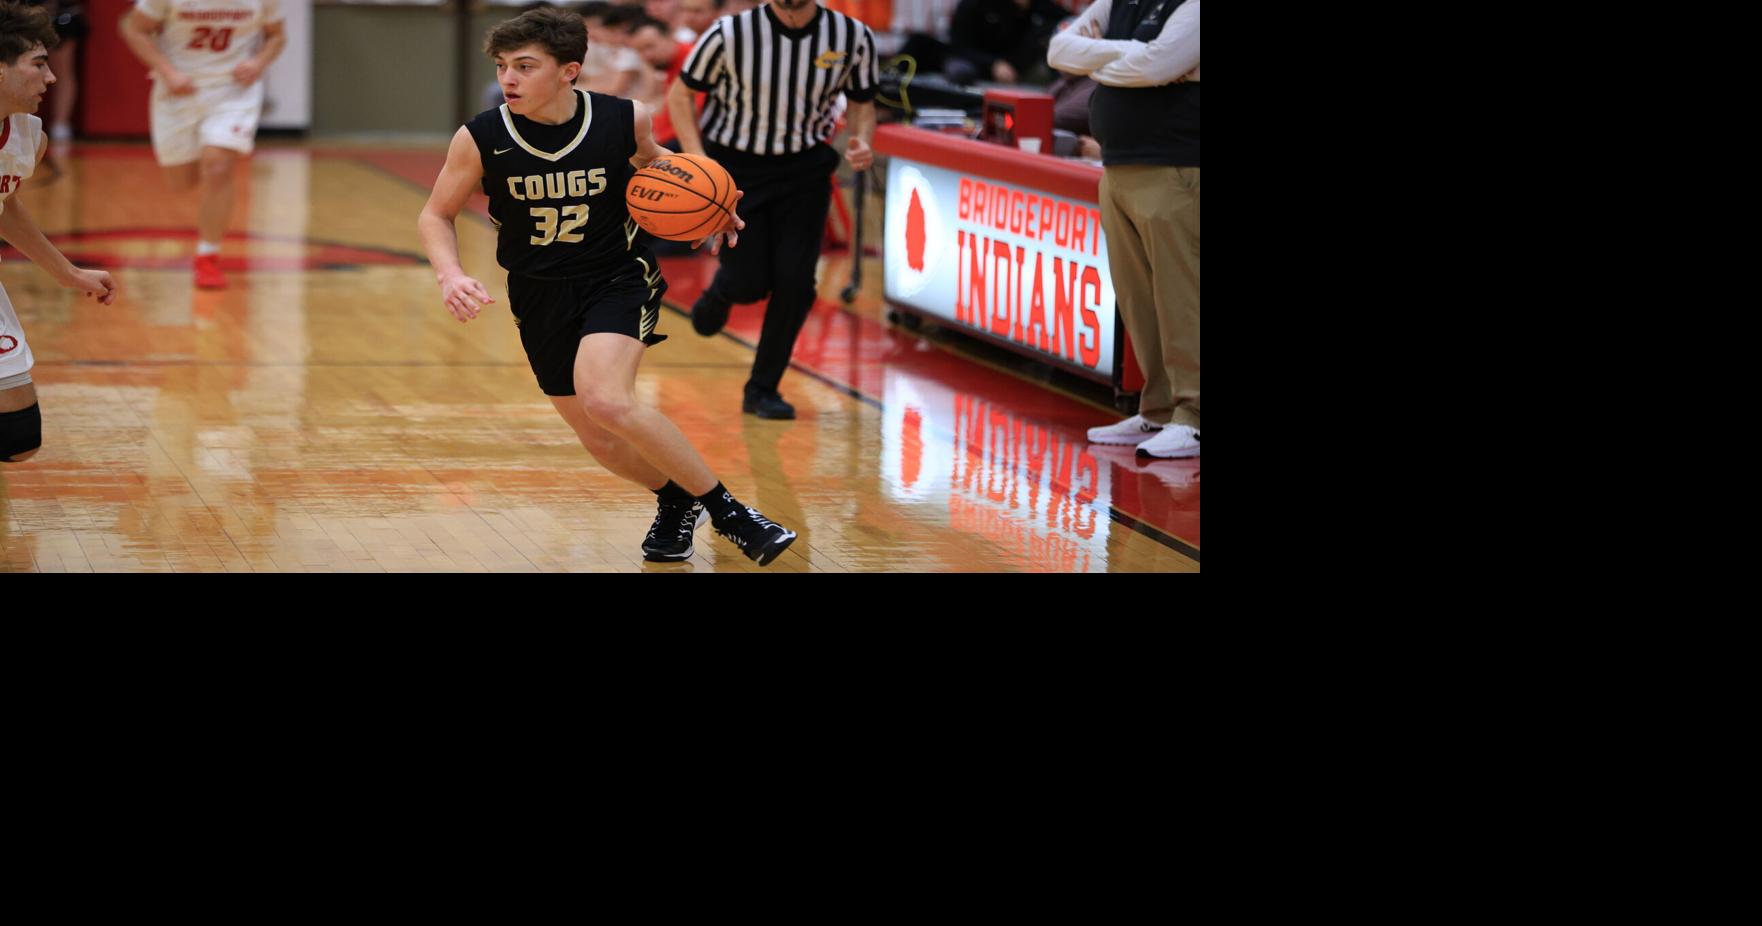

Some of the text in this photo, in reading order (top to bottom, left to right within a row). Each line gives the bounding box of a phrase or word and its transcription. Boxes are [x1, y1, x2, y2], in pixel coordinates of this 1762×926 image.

[184, 26, 234, 53] 20
[507, 167, 607, 200] COUGS
[648, 158, 694, 183] ilson
[630, 185, 664, 202] EVO
[529, 203, 590, 246] 32
[957, 176, 1101, 256] BRIDGEPORT
[954, 229, 1101, 369] INDIANS
